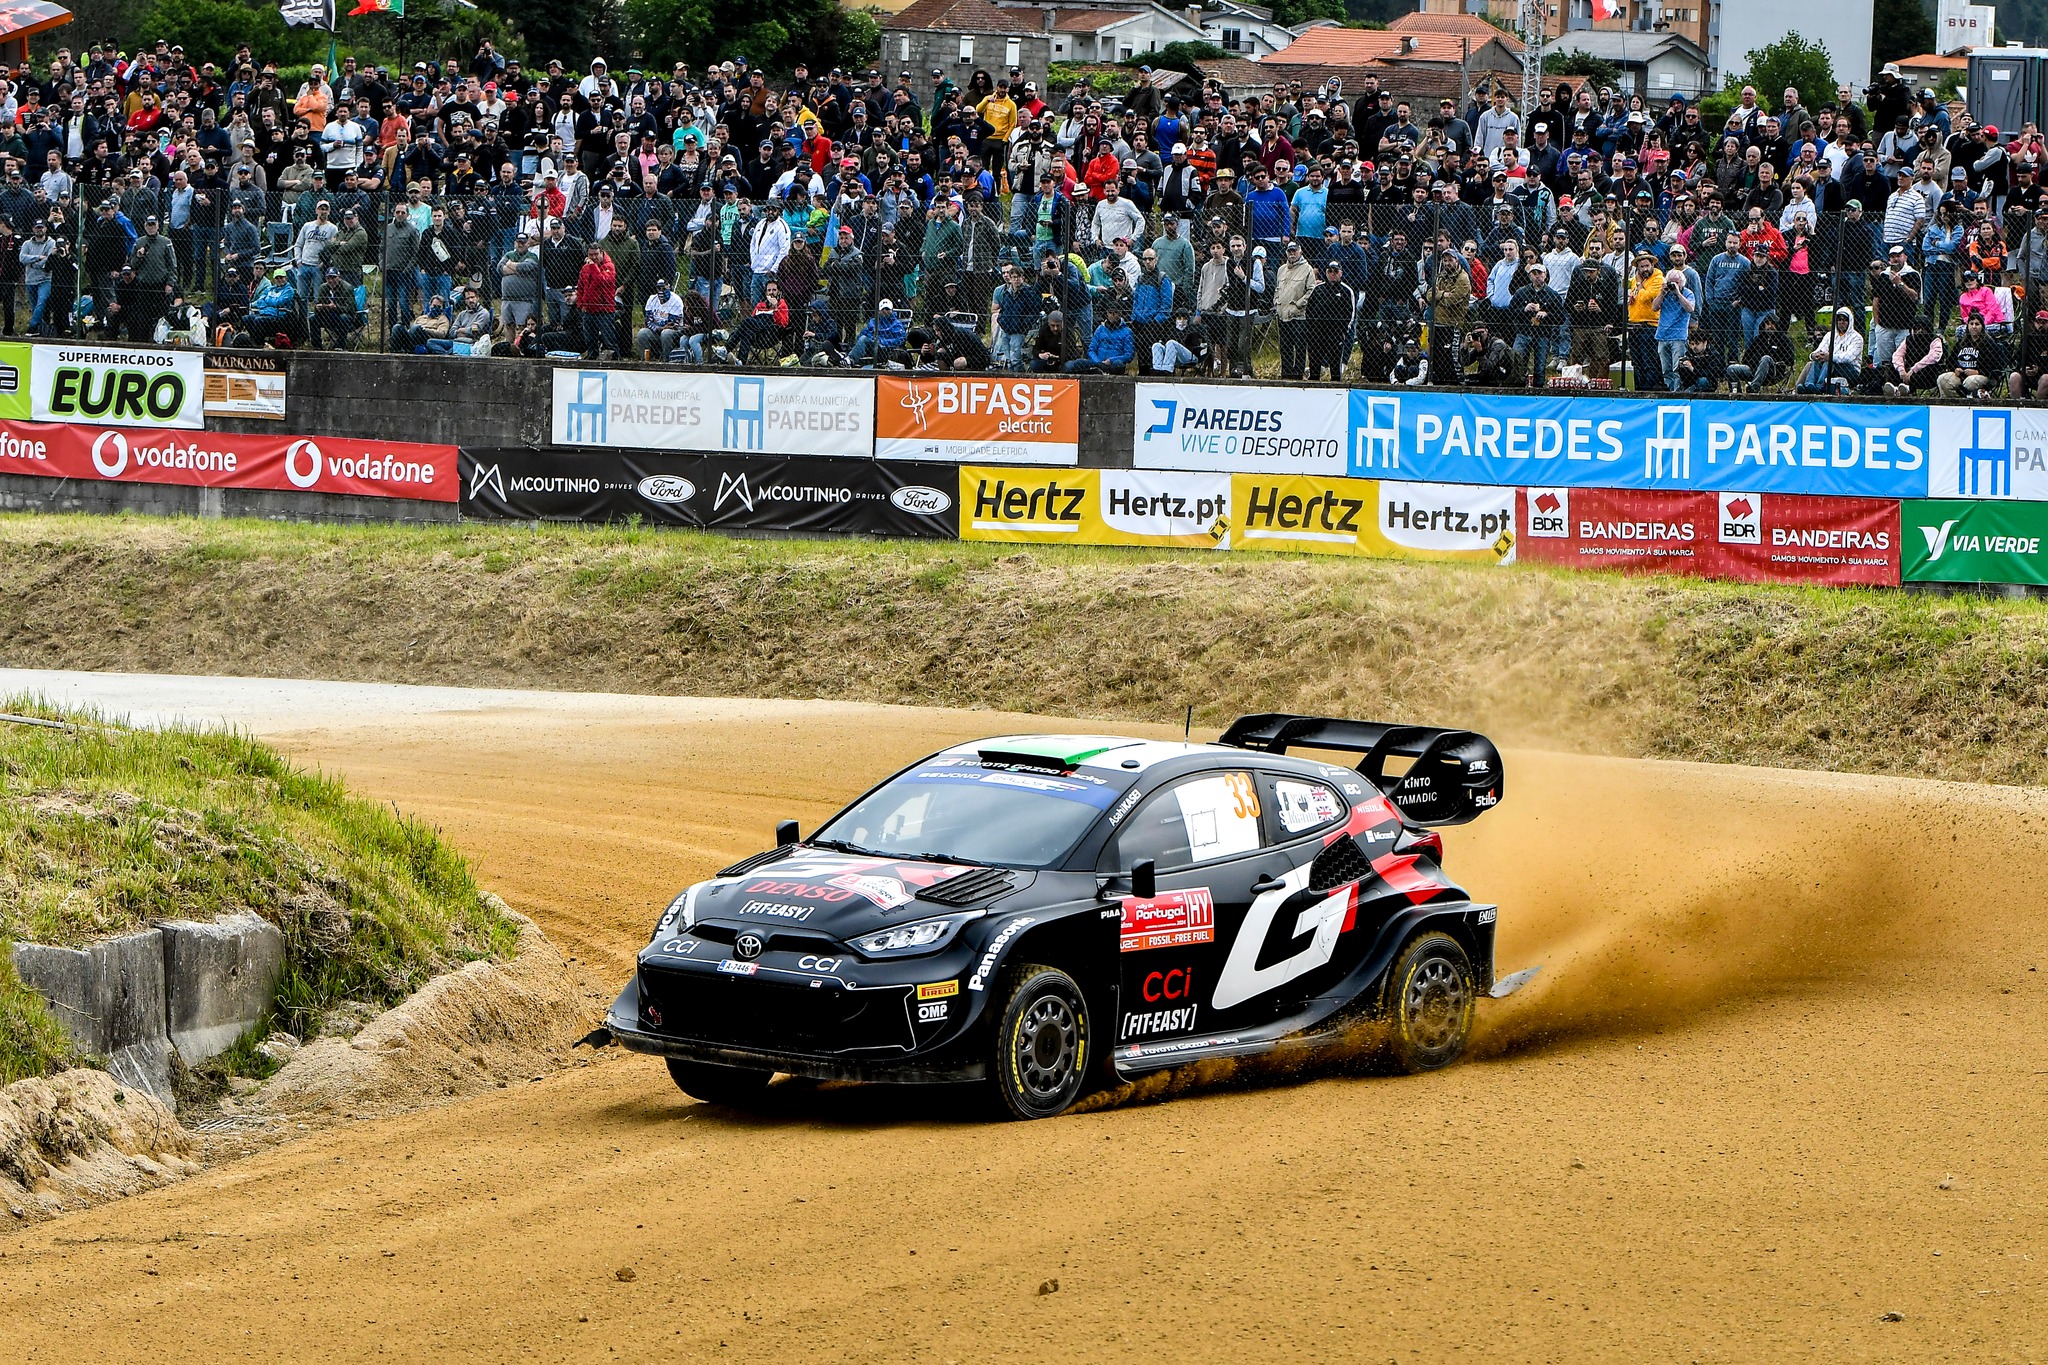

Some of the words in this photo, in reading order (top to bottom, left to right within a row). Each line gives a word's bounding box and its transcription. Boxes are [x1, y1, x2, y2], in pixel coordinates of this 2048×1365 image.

[1948, 18, 1977, 28] BVB
[58, 351, 175, 368] SUPERMERCADOS
[50, 367, 185, 420] EURO
[652, 390, 701, 401] MUNICIPAL
[810, 395, 860, 407] MUNICIPAL
[937, 382, 1054, 416] BIFASE
[610, 403, 701, 426] PAREDES
[767, 410, 860, 432] PAREDES
[998, 417, 1052, 434] electric
[1182, 408, 1283, 432] PAREDES
[1181, 434, 1221, 454] VIVE
[1224, 435, 1238, 455] O
[1241, 437, 1339, 459] DESPORTO
[1416, 413, 1624, 462] PAREDES
[1707, 422, 1924, 471] PAREDES
[133, 442, 238, 474] vodafone
[328, 452, 435, 485] vodafone
[510, 476, 600, 493] MCOUTINHO
[650, 479, 683, 498] Ford
[758, 485, 852, 503] MCOUTINHO
[855, 492, 886, 500] DRIVES
[903, 490, 938, 510] Ford
[973, 479, 1086, 522] Hertz
[1109, 488, 1227, 526] Hertz.pt
[1245, 486, 1365, 533] Hertz
[1388, 500, 1510, 539] Hertz.pt
[1532, 517, 1563, 532] BDR
[1723, 523, 1756, 538] BDR
[1579, 521, 1695, 541] BANDEIRAS
[1772, 528, 1890, 550] BANDEIRAS
[1579, 547, 1604, 555] DAMOS
[1606, 548, 1645, 556] MOVIMENTO
[1952, 535, 1983, 552] VIA
[1984, 536, 2040, 554] VERDE
[1771, 554, 1797, 562] DAMOS
[1798, 556, 1839, 564] MOVIMENTO
[1848, 557, 1862, 565] SUA
[1864, 558, 1889, 566] MARCA
[1225, 772, 1261, 819] 33
[1397, 791, 1438, 806] TAMADIC
[745, 880, 852, 902] DENSO
[1100, 908, 1121, 920] PIAA
[1135, 905, 1186, 921] Portugal
[1188, 892, 1209, 925] HY
[1148, 932, 1192, 946] FOSSIL-FREE
[1192, 930, 1210, 941] FUEL
[967, 916, 1036, 991] Panasonic
[921, 983, 957, 997] PIRELLI
[918, 1004, 948, 1019] OMP
[1141, 1045, 1178, 1055] TOYOTA
